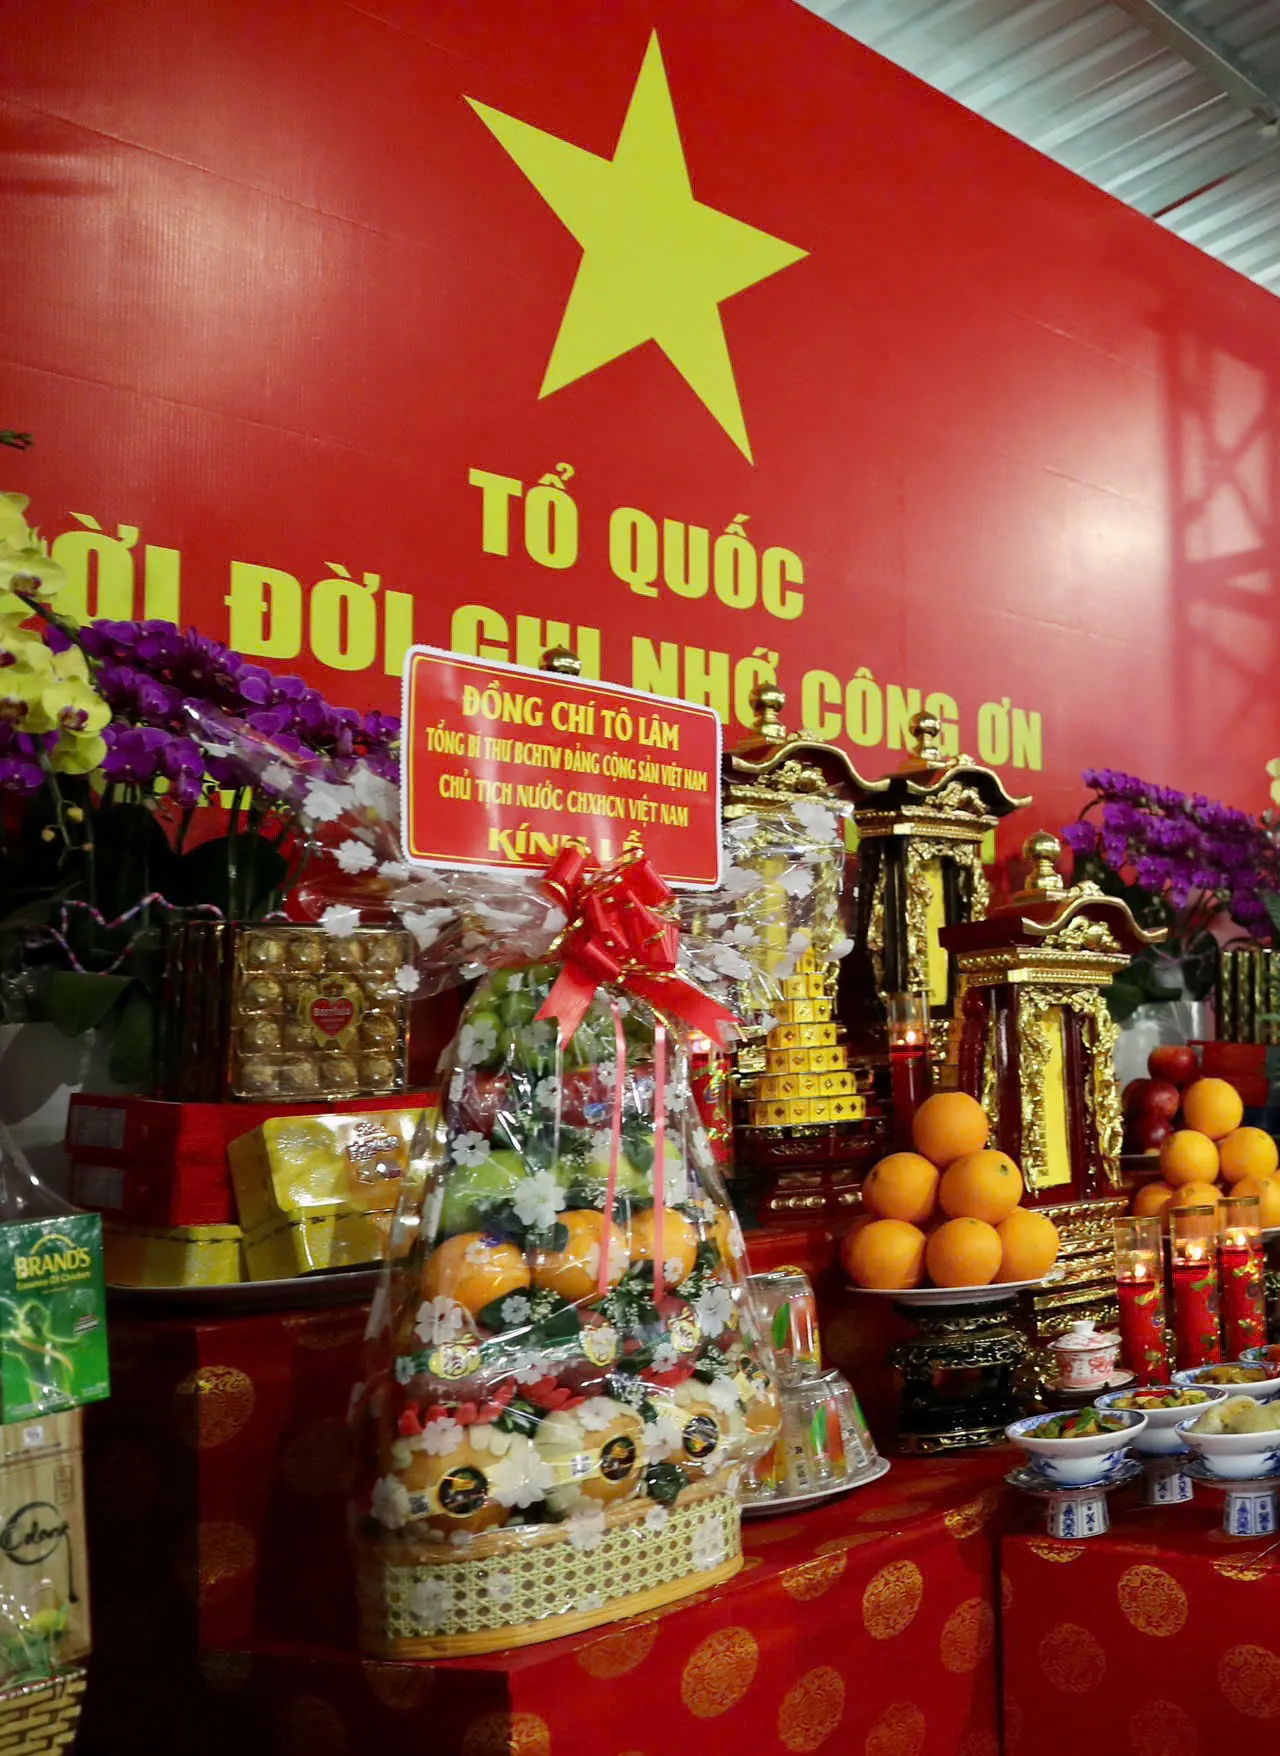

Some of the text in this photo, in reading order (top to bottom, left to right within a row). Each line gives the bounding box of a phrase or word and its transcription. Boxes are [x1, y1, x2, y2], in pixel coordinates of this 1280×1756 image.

[468, 462, 805, 620] TỔ QUỐC
[50, 511, 181, 628] ỜI
[224, 560, 414, 677] ĐỜI
[632, 635, 780, 732] NHỚ
[801, 666, 960, 757] CÔNG
[977, 697, 1043, 771] ƠN
[462, 679, 681, 751] ĐỒNG CHÍ TÔ LÂM
[425, 719, 466, 756] TỔNG
[484, 737, 513, 764] THƯ
[514, 741, 562, 769] BCHTW
[564, 743, 599, 775] ĐẢNG
[602, 751, 637, 782] CỘNG
[638, 754, 661, 785] SẢN
[661, 762, 683, 791] VIỆT
[684, 768, 709, 792] NAM
[439, 768, 689, 828] CHỦ TỊCH NƯỚC CHXHCN VIỆT NAM
